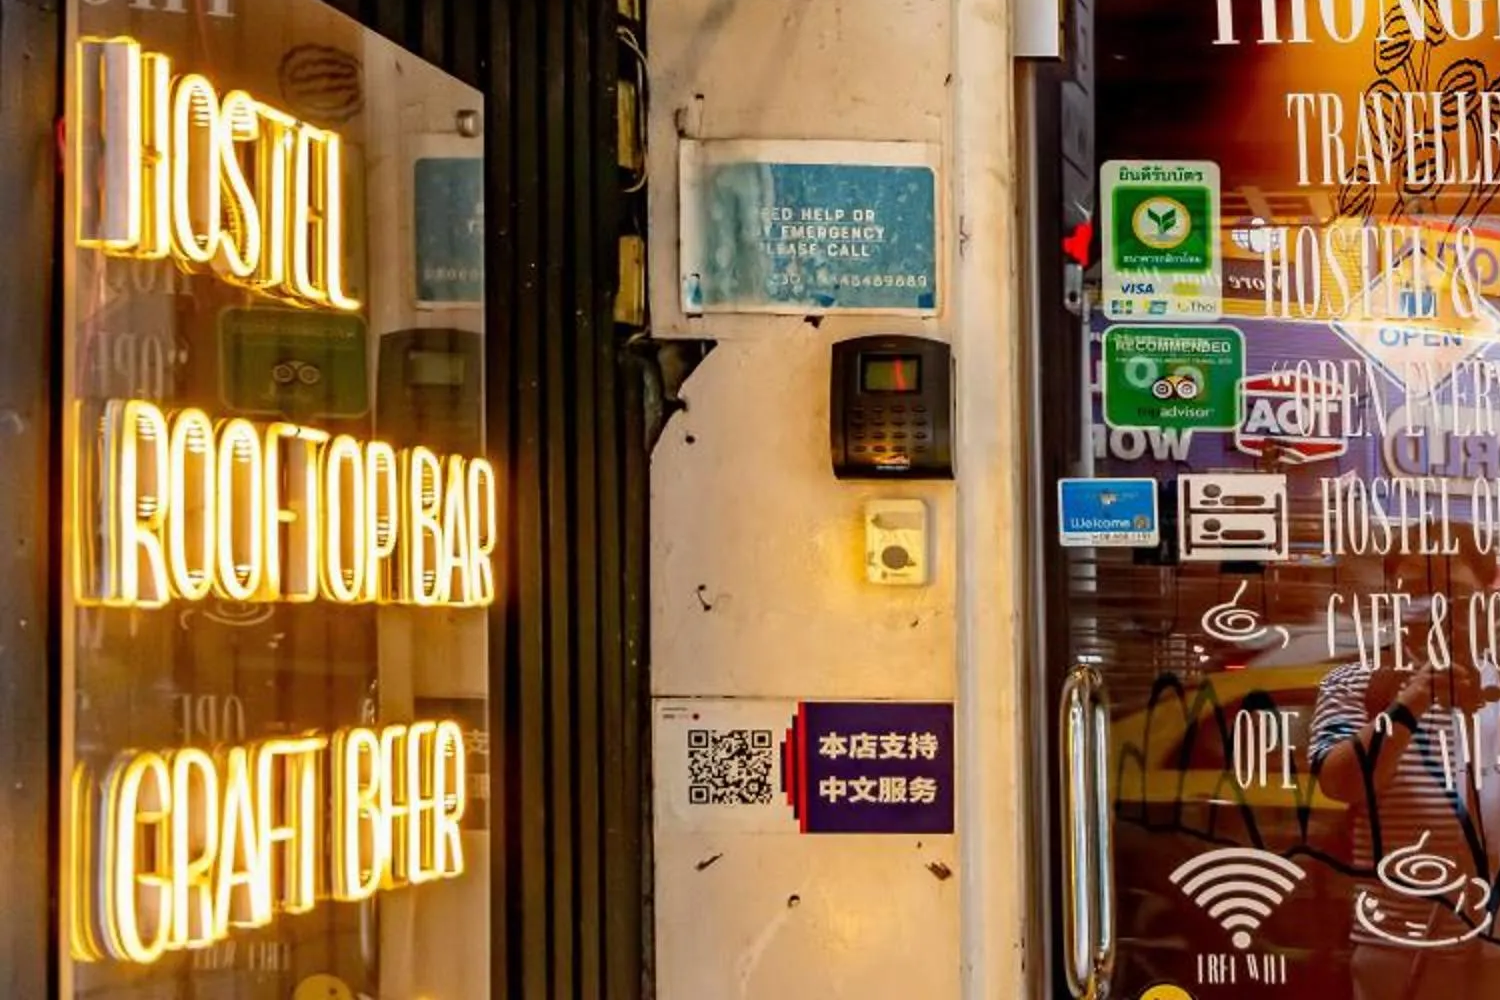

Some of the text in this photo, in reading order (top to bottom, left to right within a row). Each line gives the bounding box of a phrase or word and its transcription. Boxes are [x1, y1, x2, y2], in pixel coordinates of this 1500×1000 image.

[76, 37, 361, 311] HOSTEL
[801, 208, 845, 221] HELP
[852, 208, 875, 221] OR
[781, 226, 885, 240] EMERGENCY
[761, 243, 872, 257] LEASE CALL
[1260, 226, 1437, 320] HOSTEL
[1450, 225, 1481, 319] &
[1120, 282, 1155, 296] VISA
[1114, 340, 1232, 354] RECOMMENDED
[1377, 326, 1464, 348] OPEN
[78, 399, 496, 607] ROOFTOP BAR
[1319, 476, 1464, 556] HOSTEL
[1327, 578, 1413, 673] CAFÉ
[1428, 592, 1451, 672] &
[818, 731, 939, 760] 本店支持
[818, 775, 939, 805] 中文服务
[73, 719, 466, 963] CRAFT BEER
